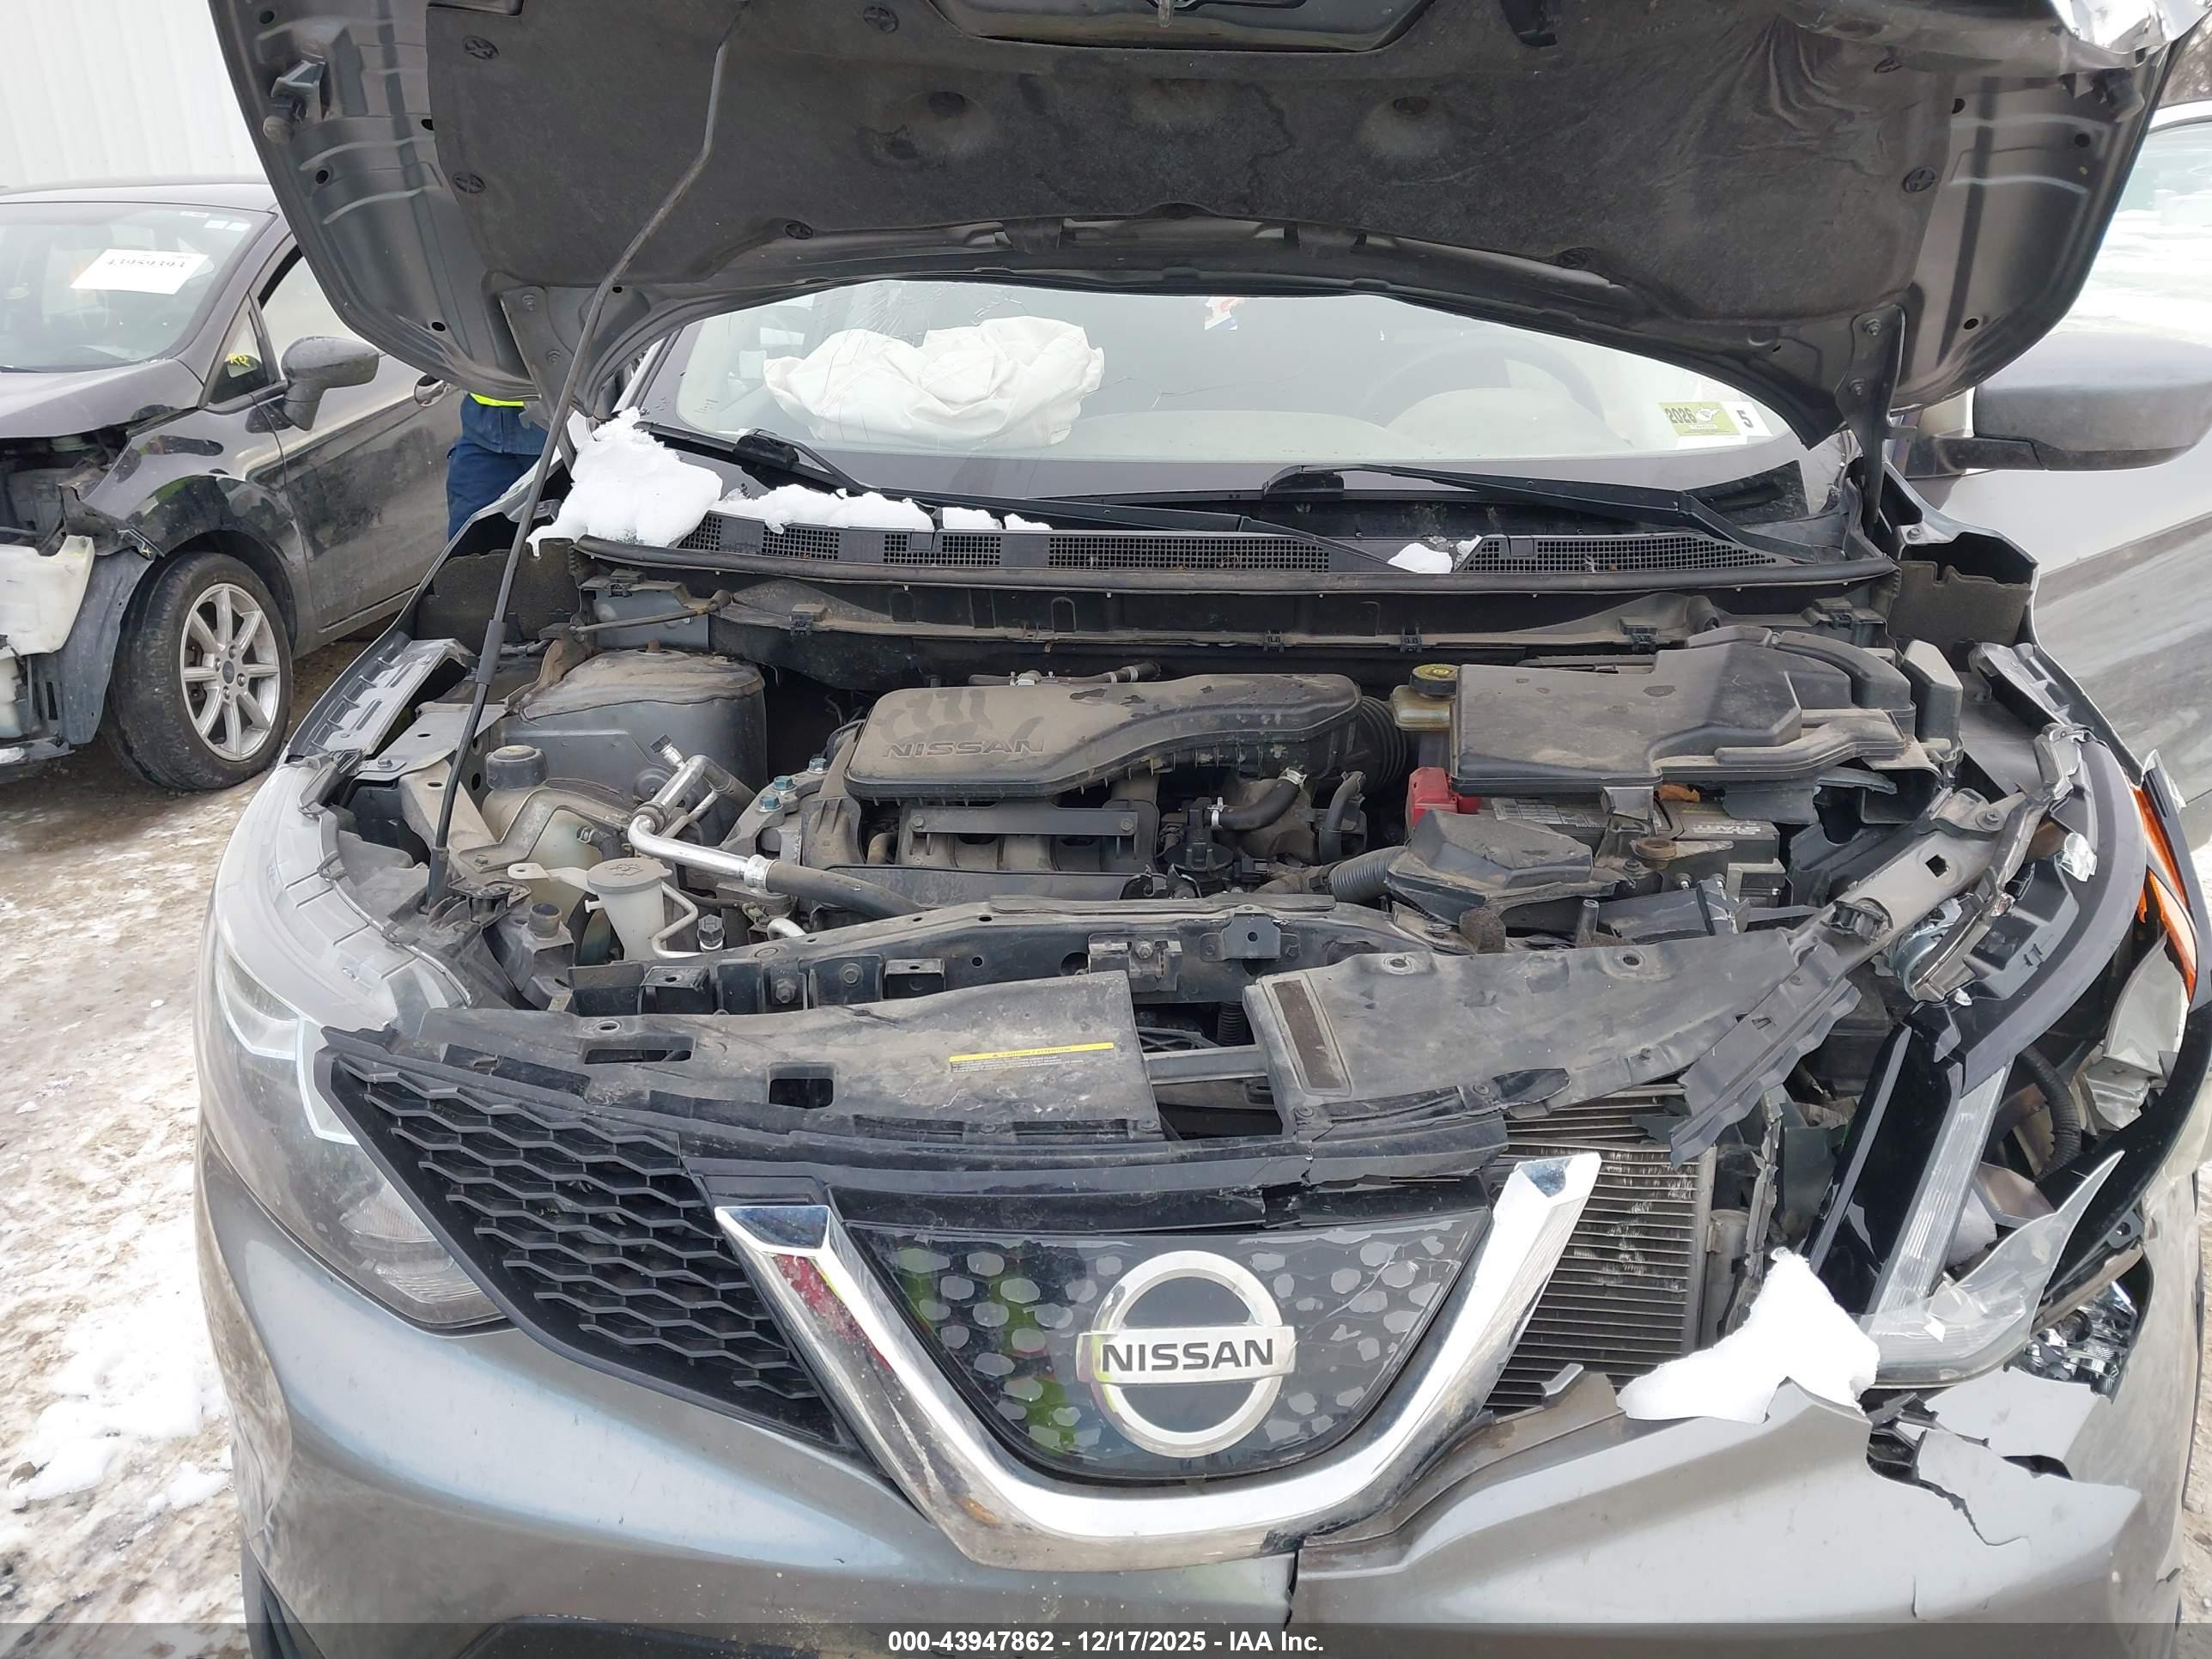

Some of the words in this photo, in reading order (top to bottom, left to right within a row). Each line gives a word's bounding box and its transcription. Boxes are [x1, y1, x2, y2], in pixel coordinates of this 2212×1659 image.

[1664, 407, 1698, 423] 2026
[1736, 410, 1753, 428] 5
[883, 738, 1045, 758] NISSAN
[1102, 1338, 1273, 1372] NISSAN
